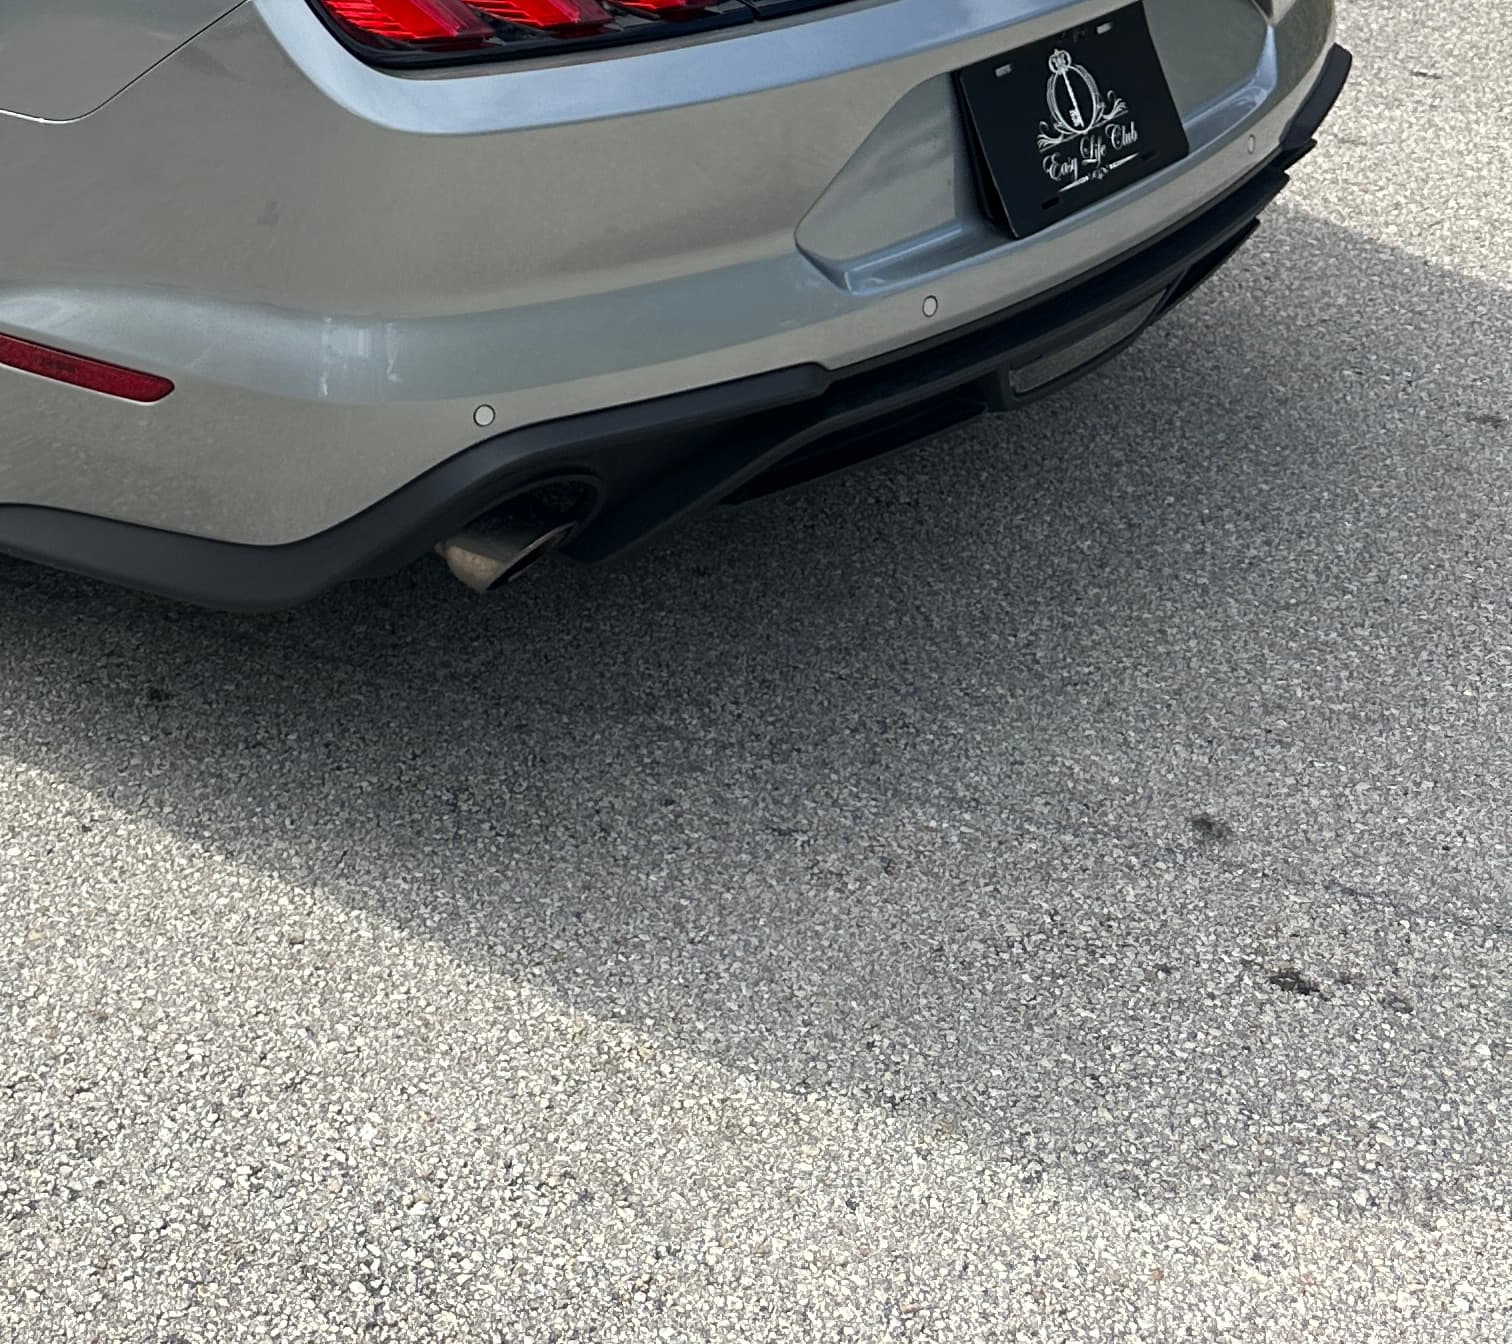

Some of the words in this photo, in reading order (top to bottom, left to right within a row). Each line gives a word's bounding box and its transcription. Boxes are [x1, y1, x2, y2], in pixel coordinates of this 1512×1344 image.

[1043, 152, 1077, 181] Easy
[1080, 134, 1106, 169] Life
[1105, 121, 1137, 149] Club
